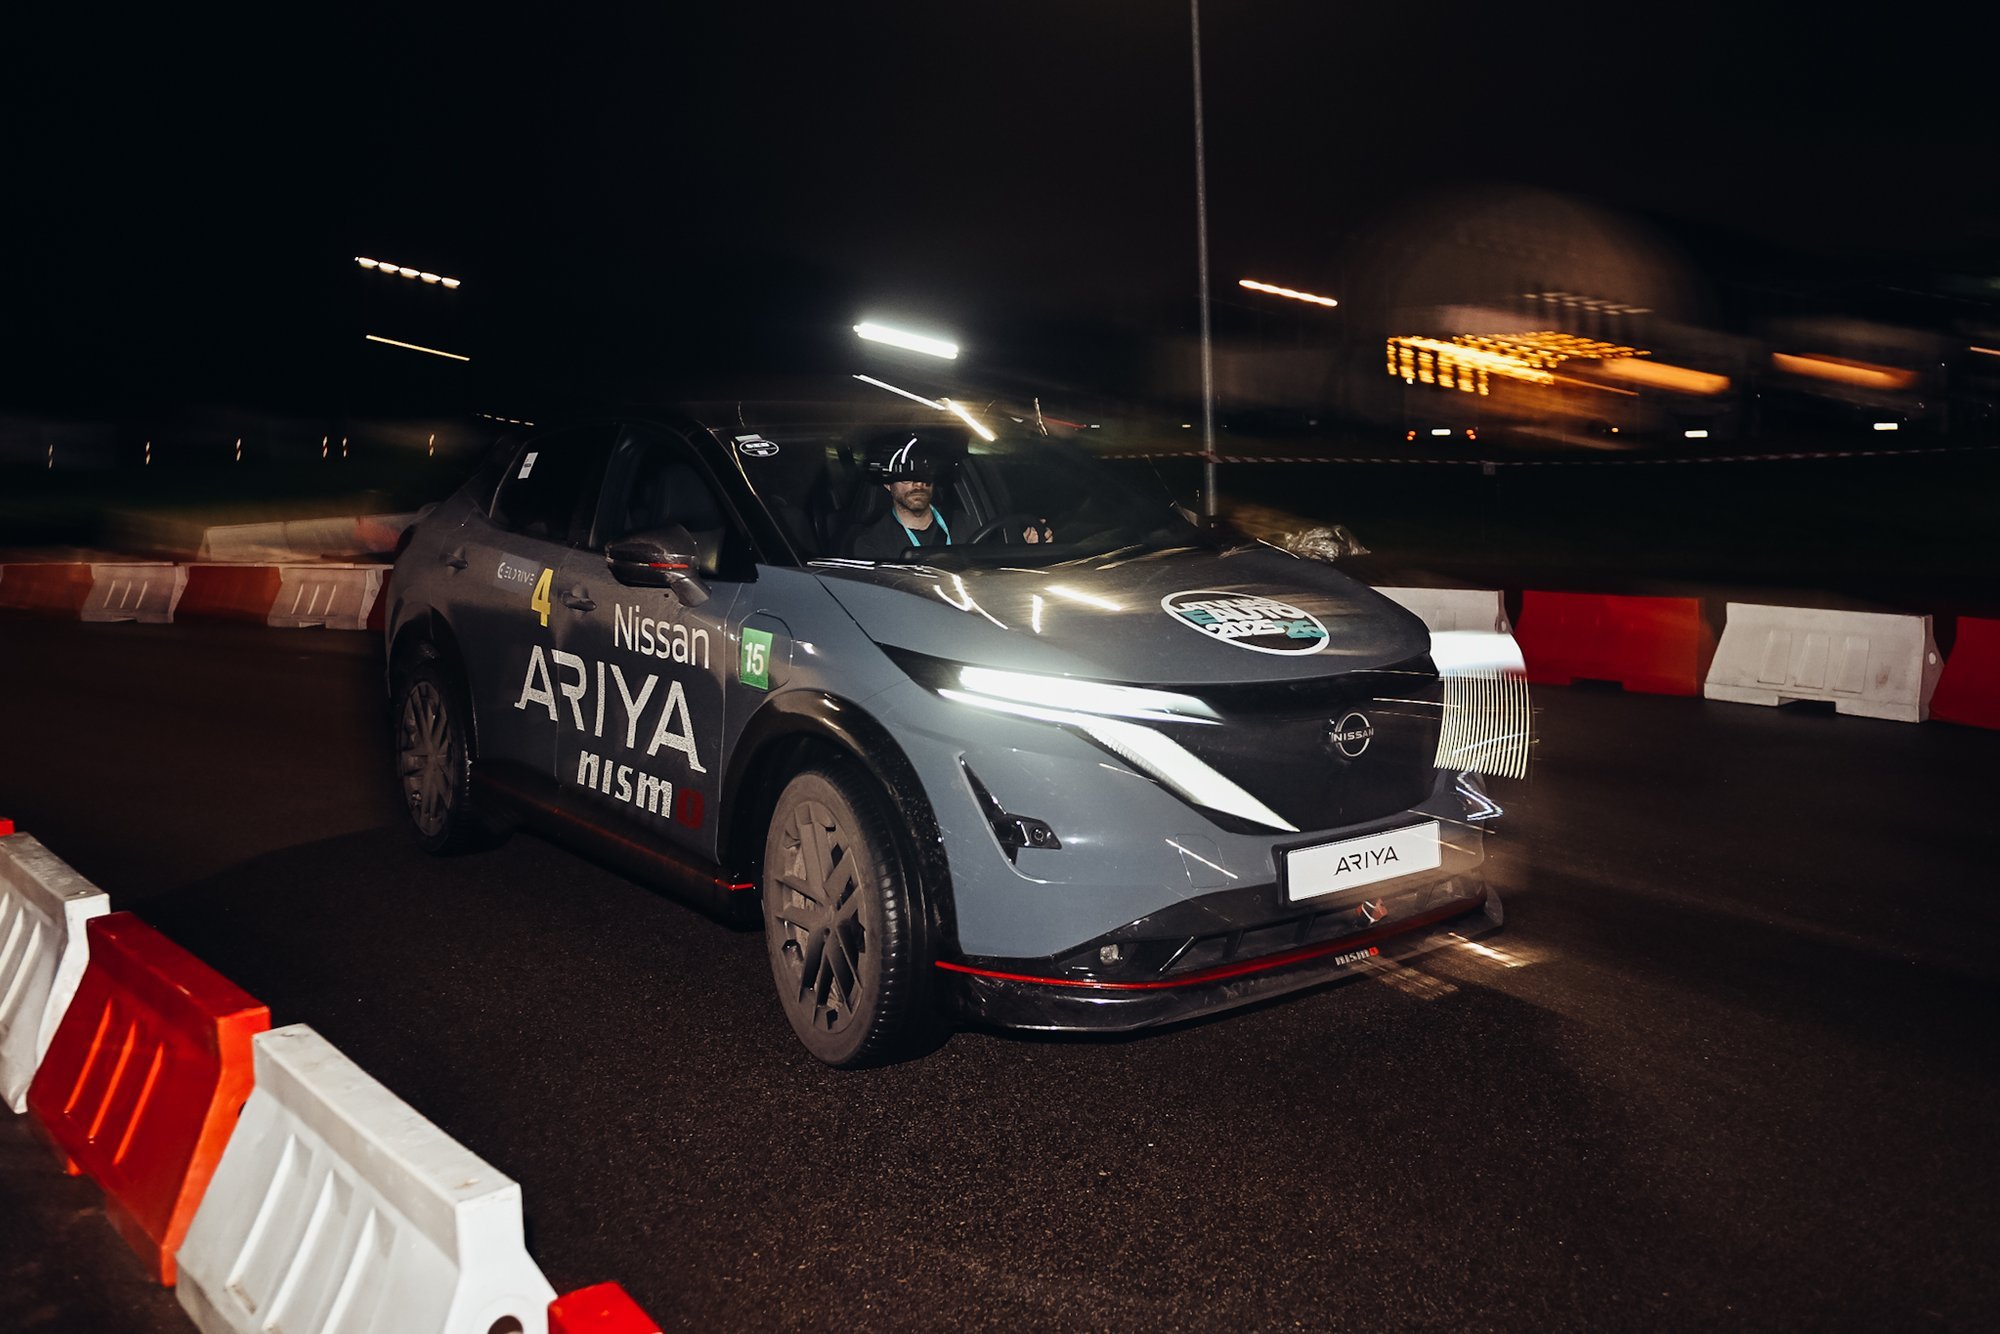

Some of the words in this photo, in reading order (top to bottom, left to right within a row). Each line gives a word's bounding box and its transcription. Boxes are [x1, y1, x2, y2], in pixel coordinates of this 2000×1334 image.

[531, 568, 554, 628] 4
[613, 603, 710, 670] Nissan
[744, 642, 765, 676] 15
[513, 645, 707, 774] ARIYA
[1333, 727, 1375, 743] NISSAN
[577, 749, 705, 830] nismo
[1334, 846, 1400, 876] ARIYA
[1334, 946, 1380, 967] nismo
